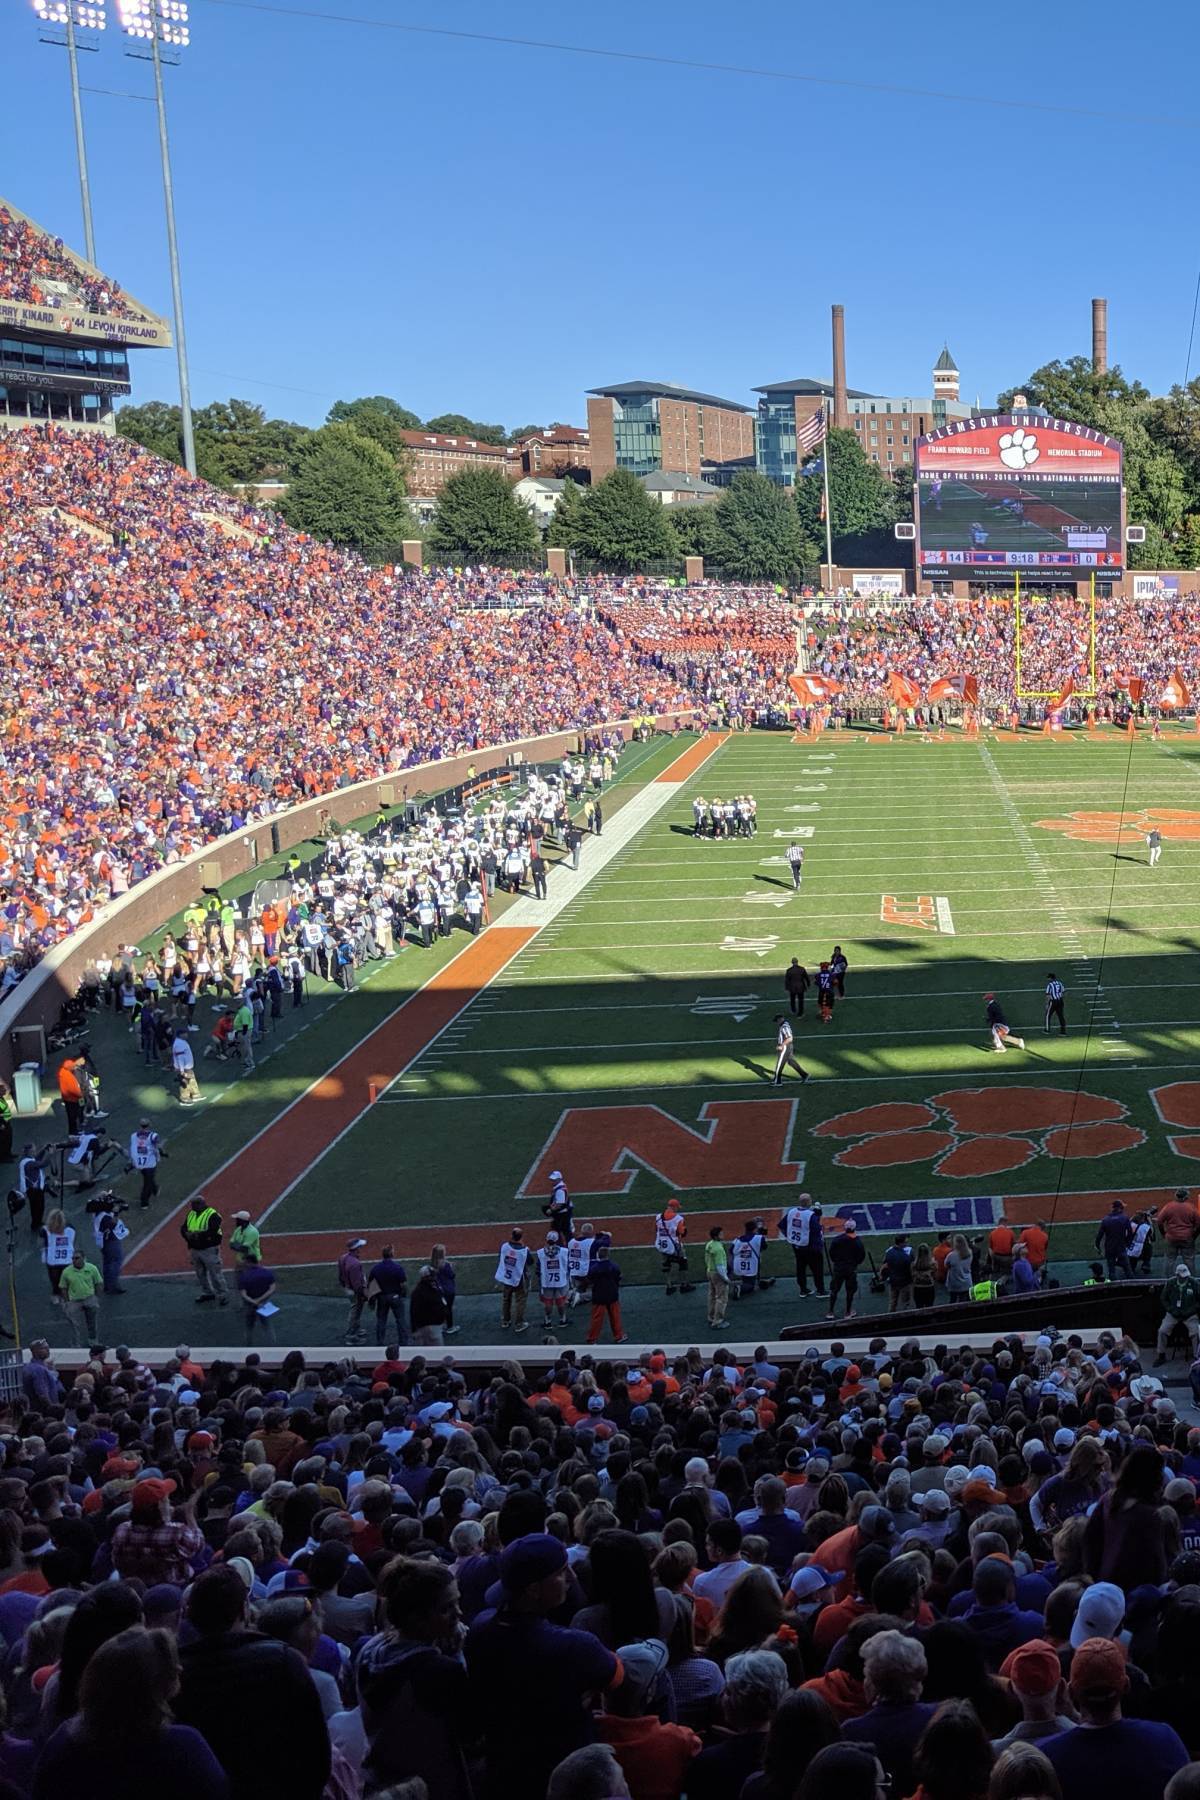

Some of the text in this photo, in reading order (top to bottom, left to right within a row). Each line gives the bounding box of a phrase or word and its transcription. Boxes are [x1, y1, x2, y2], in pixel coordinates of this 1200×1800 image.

[23, 309, 54, 323] KINARD
[88, 320, 116, 333] LEVON
[117, 325, 158, 339] KIRKLAND
[94, 382, 130, 394] NISSAN
[926, 416, 1111, 445] CLEMSON UNIVERSITY
[928, 445, 947, 454] FRANK
[973, 447, 990, 455] FIELD
[1047, 449, 1103, 458] MEMORIAL STADIUM
[920, 471, 940, 480] HOME
[955, 472, 968, 480] THE
[1079, 475, 1120, 483] CHAMPIONS
[1061, 525, 1113, 534] REPLAY
[949, 553, 961, 563] 14
[1010, 552, 1034, 564] 9:18
[1086, 553, 1092, 564] 0
[137, 1157, 148, 1166] 17
[54, 1249, 68, 1259] 39
[740, 1261, 751, 1271] 91
[548, 1272, 561, 1282] 75
